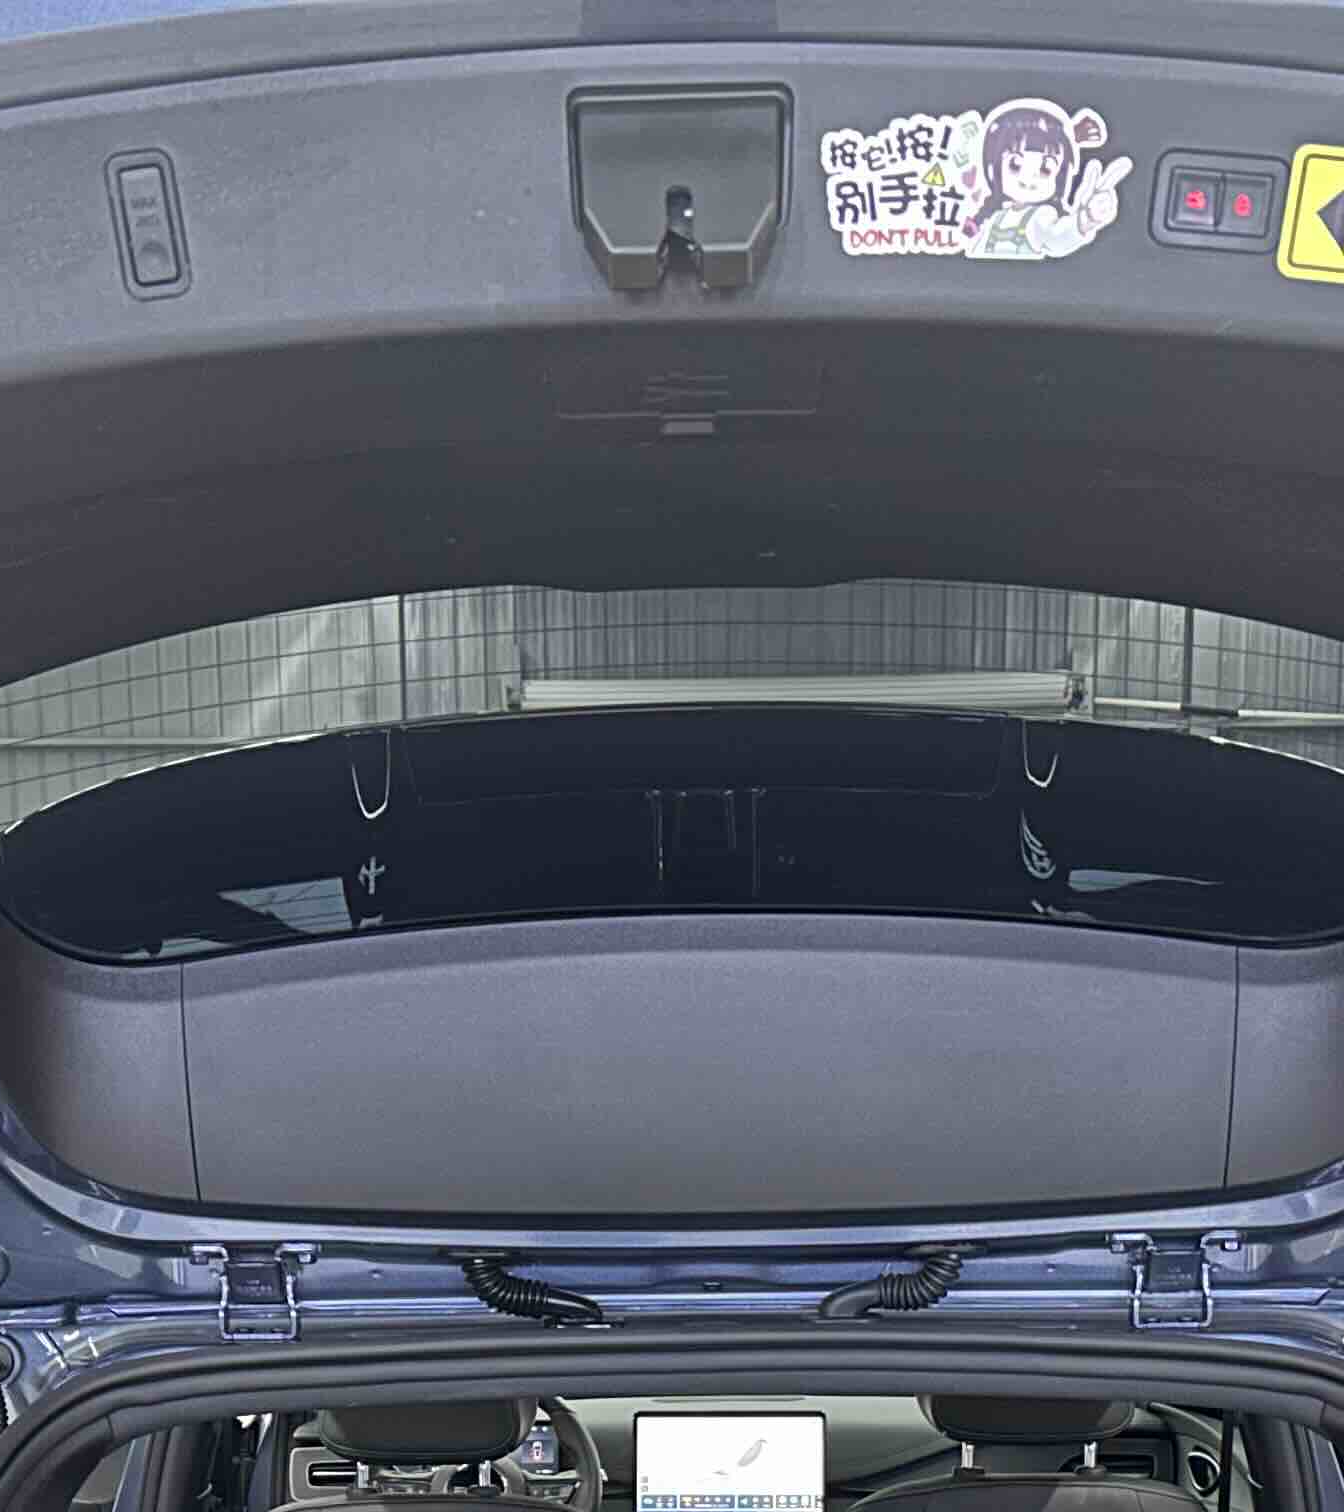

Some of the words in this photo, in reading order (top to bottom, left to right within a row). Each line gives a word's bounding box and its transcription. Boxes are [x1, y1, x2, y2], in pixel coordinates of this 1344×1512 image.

[835, 171, 965, 227] 别手拉
[913, 228, 959, 248] PULL
